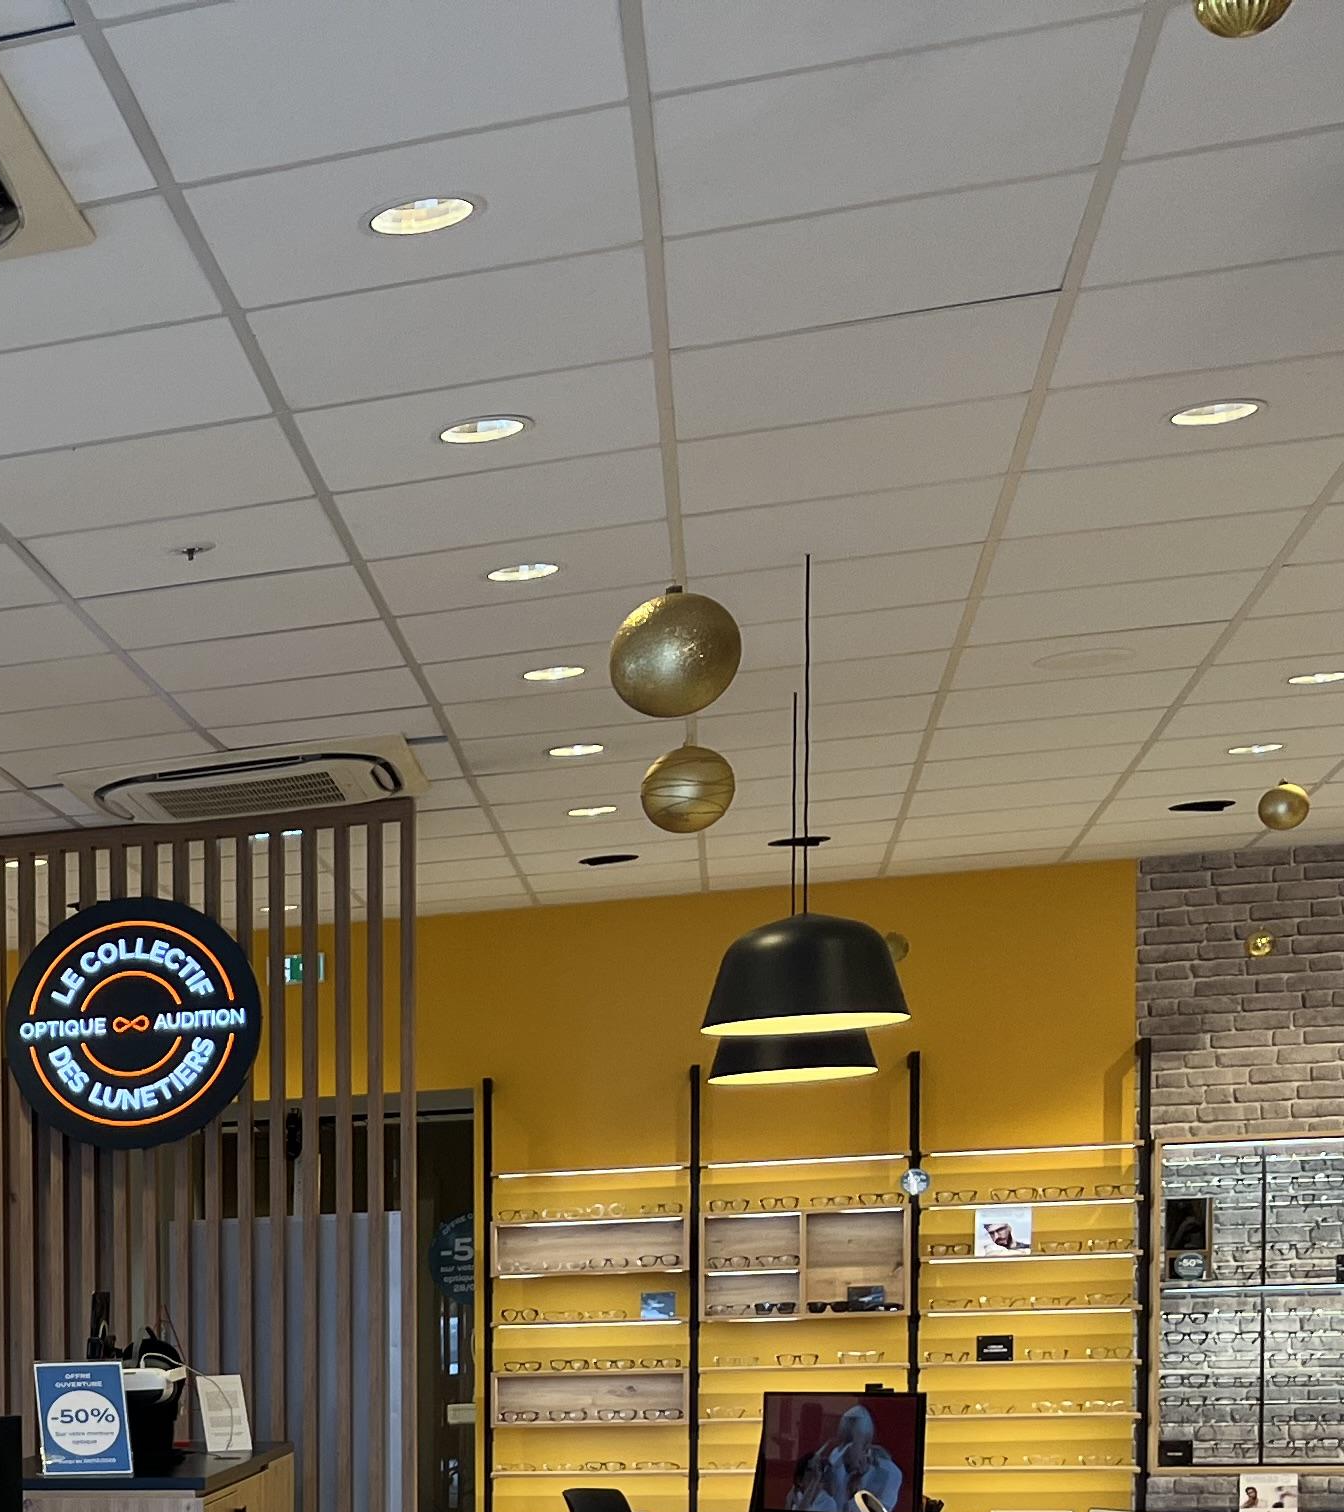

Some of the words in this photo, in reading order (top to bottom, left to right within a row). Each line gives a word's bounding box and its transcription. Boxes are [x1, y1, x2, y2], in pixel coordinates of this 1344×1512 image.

[51, 967, 85, 1007] LE
[80, 937, 214, 997] COLLECTIF
[19, 1017, 107, 1041] OPTIQUE
[153, 1007, 246, 1031] AUDITION
[48, 1045, 90, 1093] DES
[88, 1036, 216, 1110] LUNETIERS
[440, 1237, 474, 1261] -5
[64, 1372, 91, 1380] OFFRE
[50, 1407, 115, 1424] -50%
